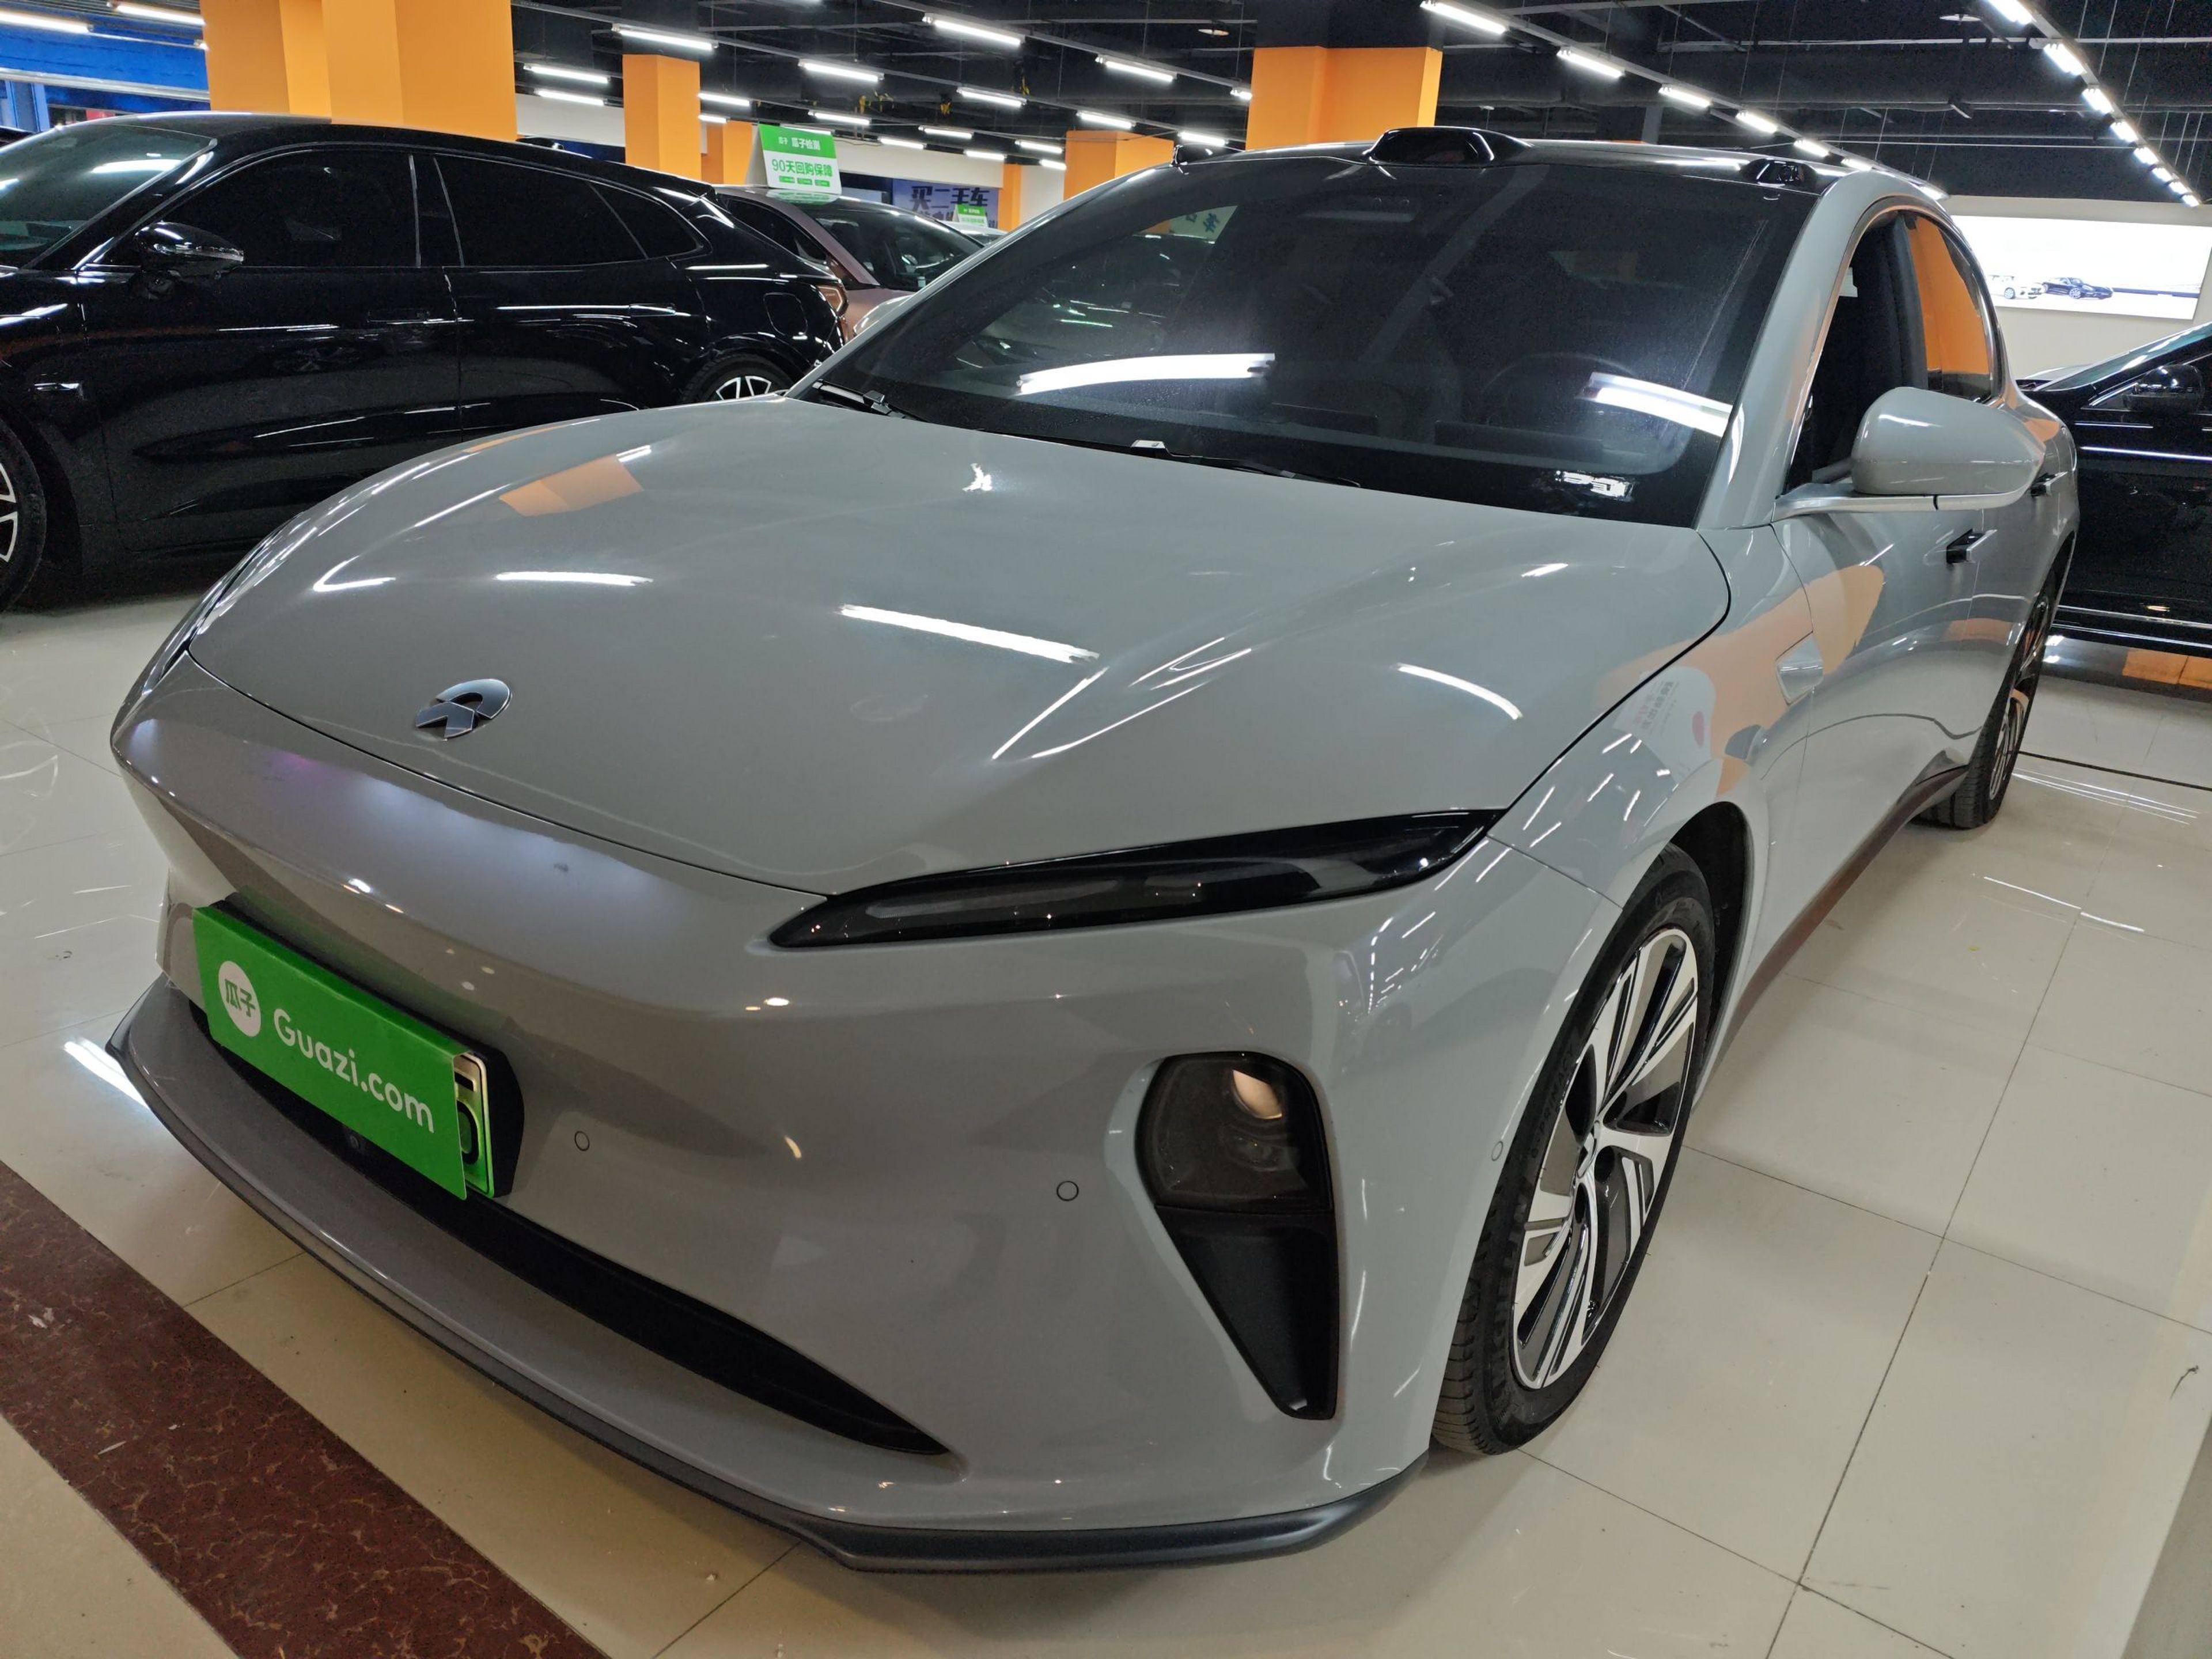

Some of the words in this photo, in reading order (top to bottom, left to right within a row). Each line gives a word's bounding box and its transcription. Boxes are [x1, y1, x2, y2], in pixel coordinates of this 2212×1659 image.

[771, 158, 833, 177] 90天回购保障
[224, 979, 256, 1018] 瓜子
[274, 1008, 434, 1134] Guazi.com
